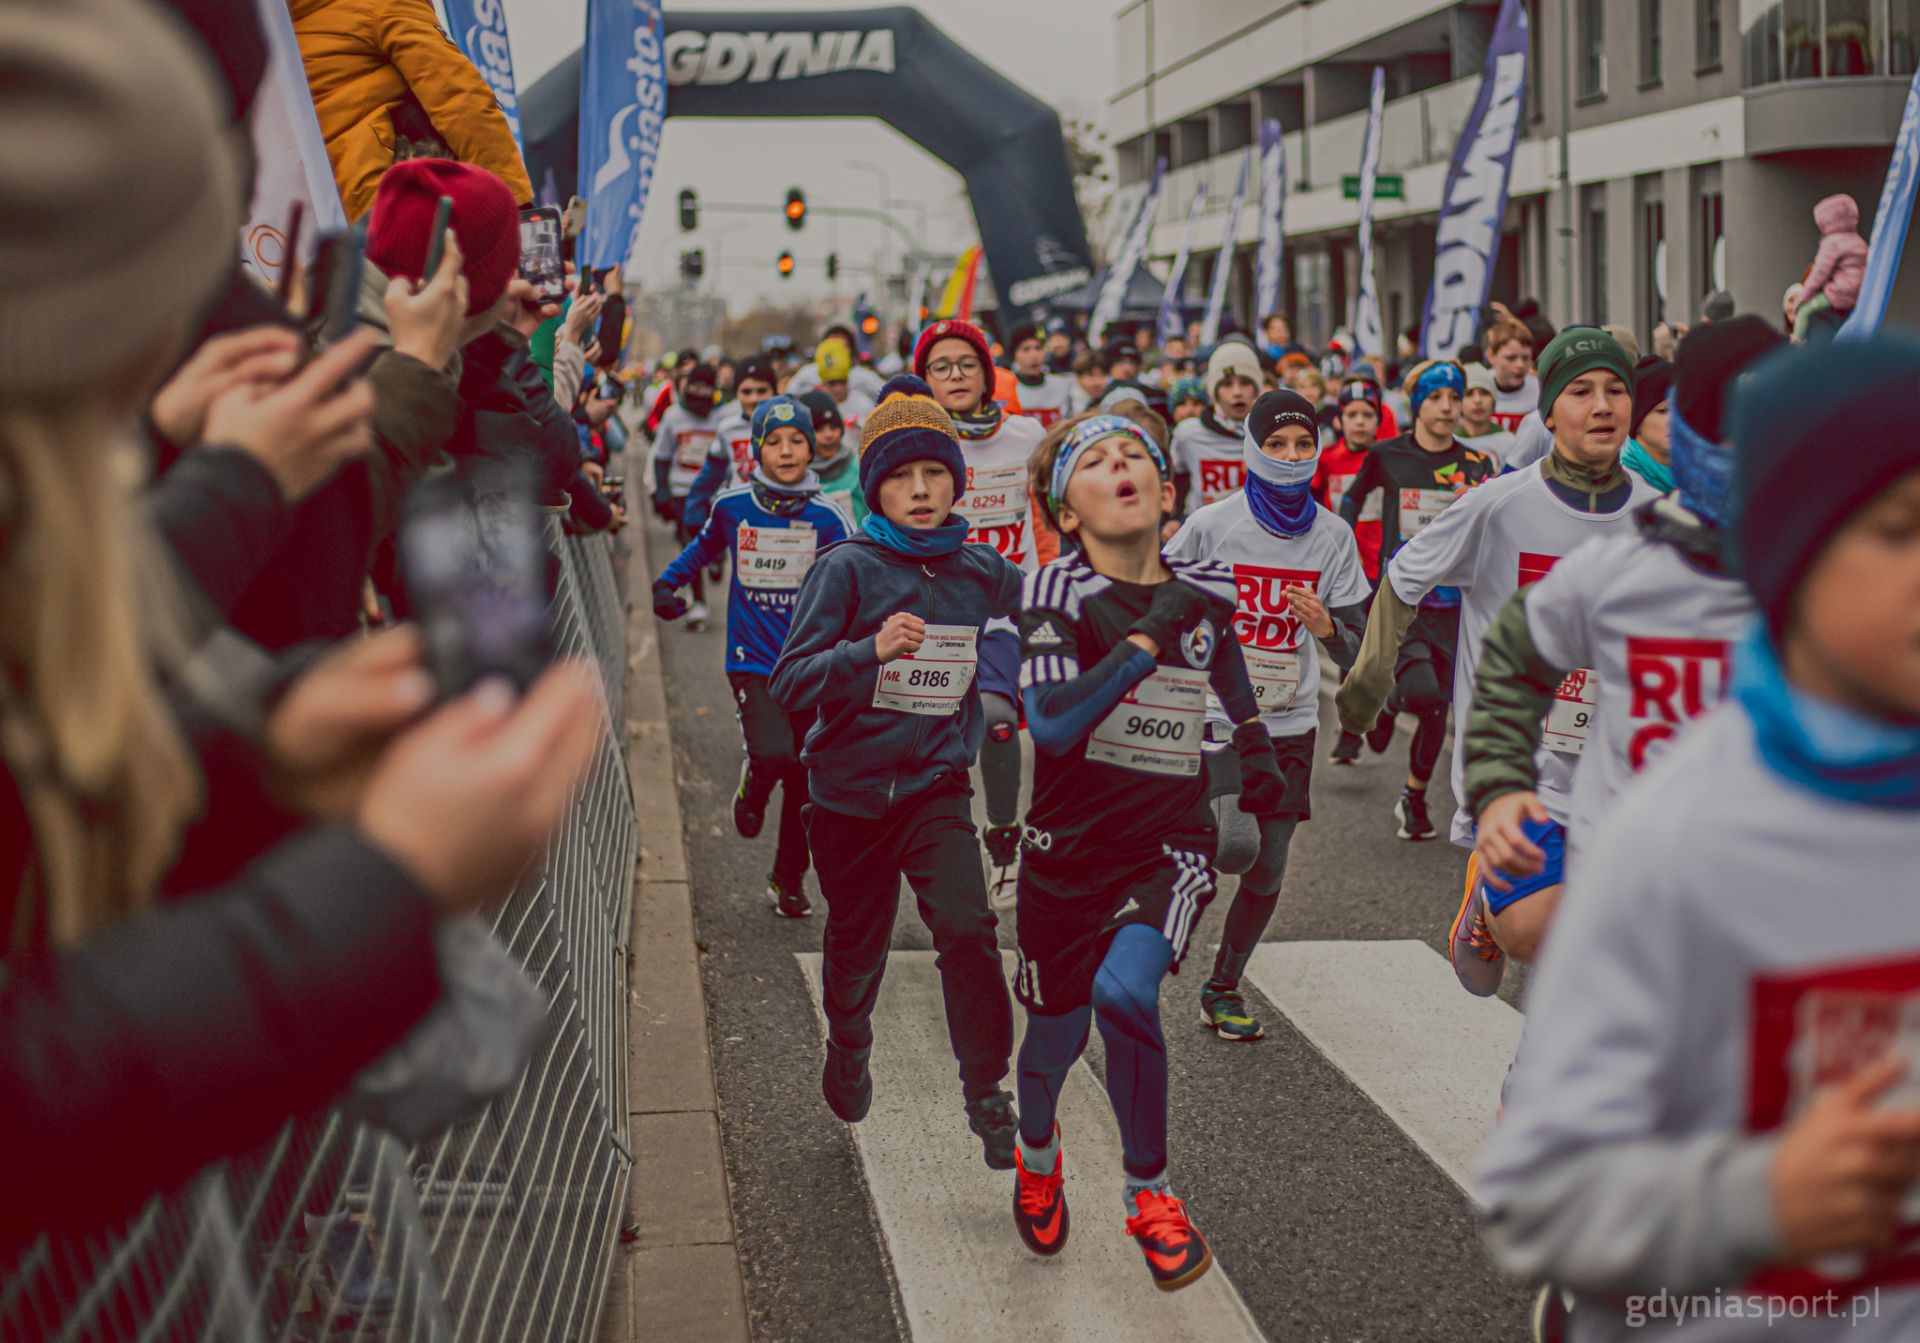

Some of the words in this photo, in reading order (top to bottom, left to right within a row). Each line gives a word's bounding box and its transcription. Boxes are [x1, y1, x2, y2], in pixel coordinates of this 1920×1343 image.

[665, 29, 895, 85] GDYNIA
[1201, 464, 1247, 492] RU
[972, 494, 1005, 509] 8294
[754, 558, 786, 570] 8419
[909, 669, 950, 687] 8186
[1562, 671, 1587, 685] UN
[1250, 684, 1265, 698] 8
[1124, 716, 1185, 740] 9600
[1573, 712, 1592, 729] 9
